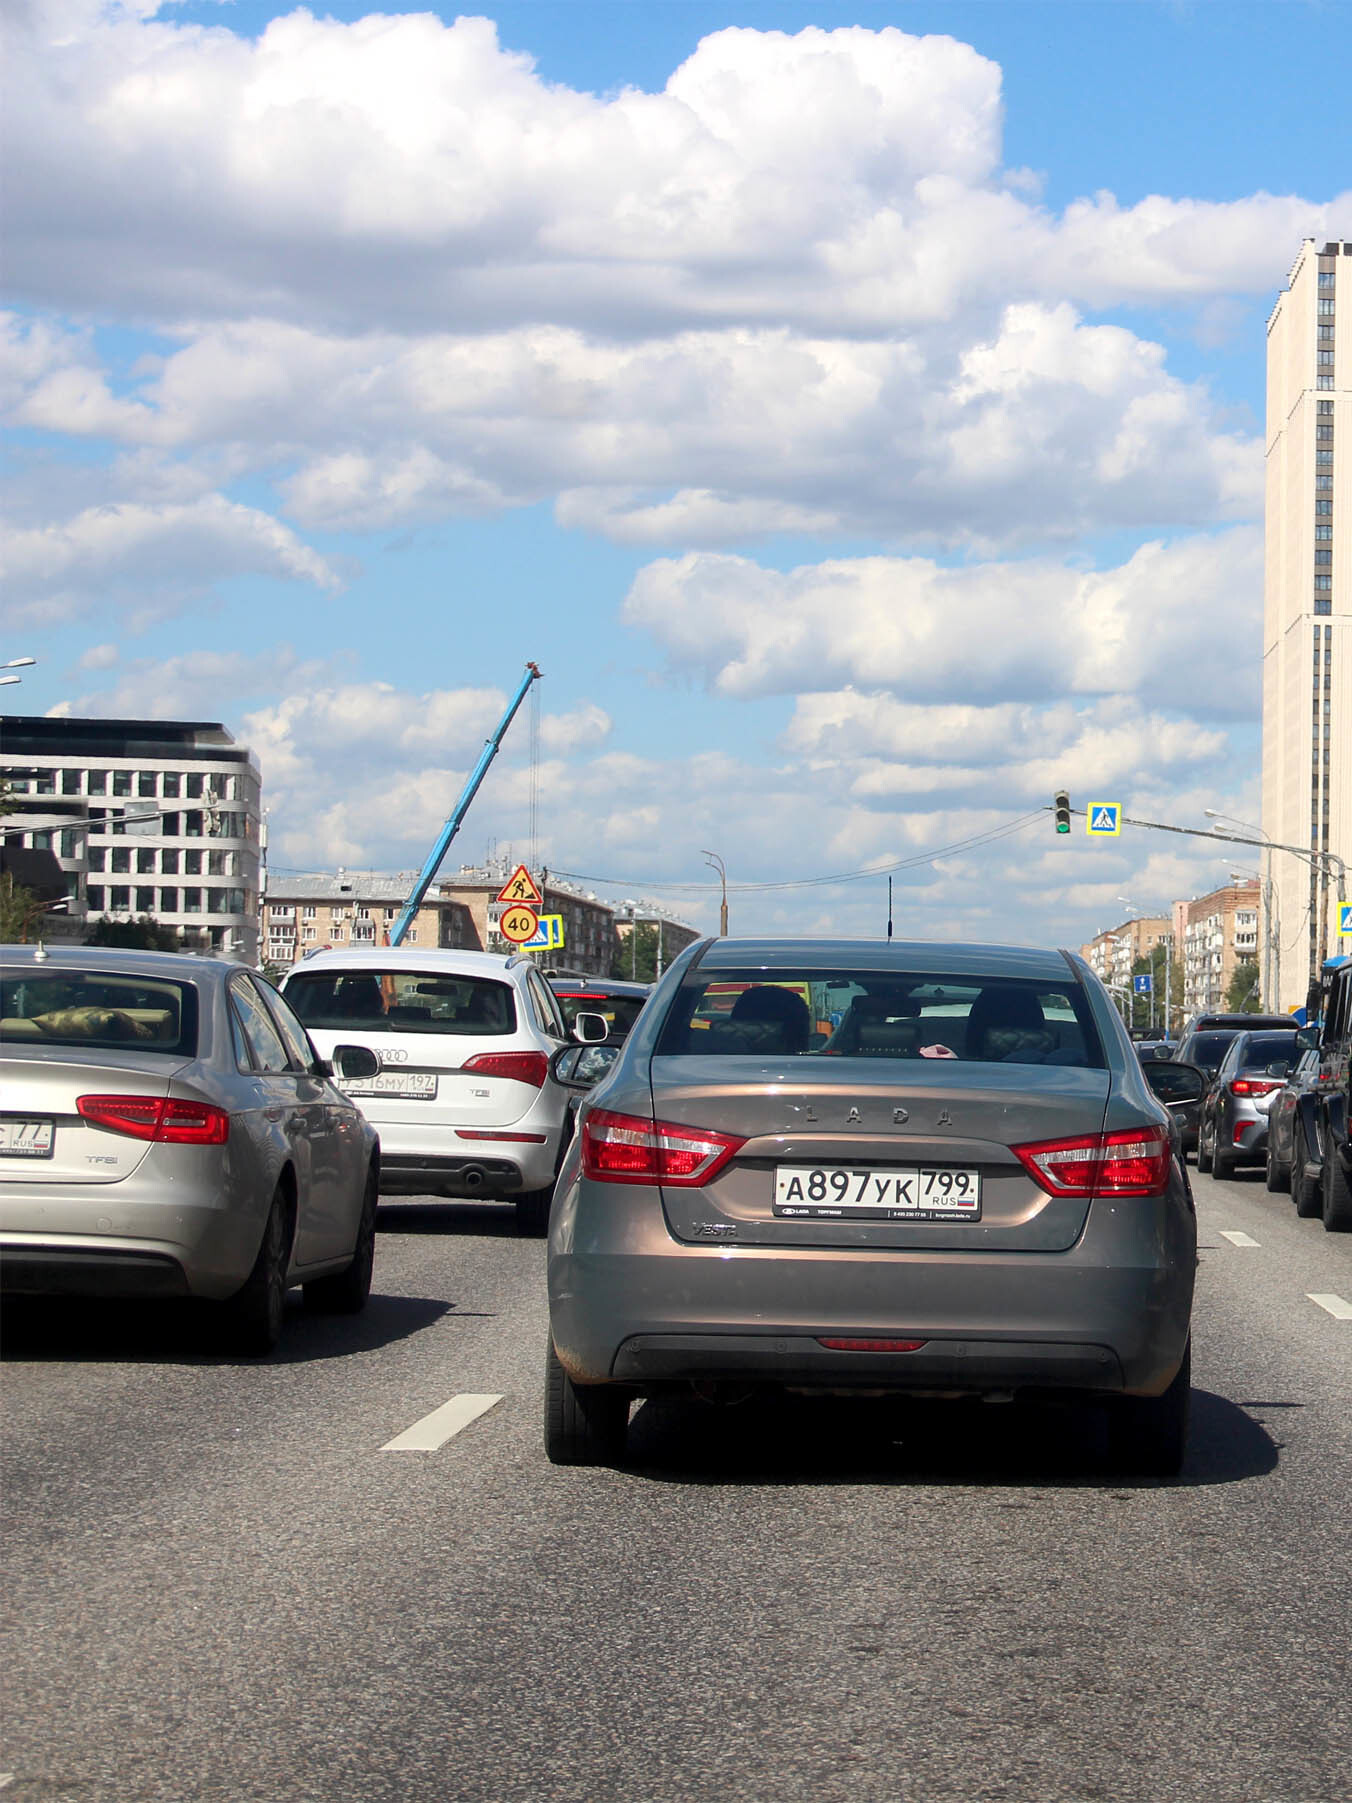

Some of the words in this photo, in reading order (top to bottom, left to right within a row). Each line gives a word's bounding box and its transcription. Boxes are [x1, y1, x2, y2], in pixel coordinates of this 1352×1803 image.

[508, 917, 530, 931] 40
[410, 1075, 432, 1088] 197
[806, 1105, 953, 1126] LADA
[17, 1120, 43, 1140] 77
[85, 1155, 118, 1164] TFSI
[786, 1170, 914, 1203] А897УК
[922, 1171, 971, 1196] 799
[932, 1197, 957, 1206] RUS
